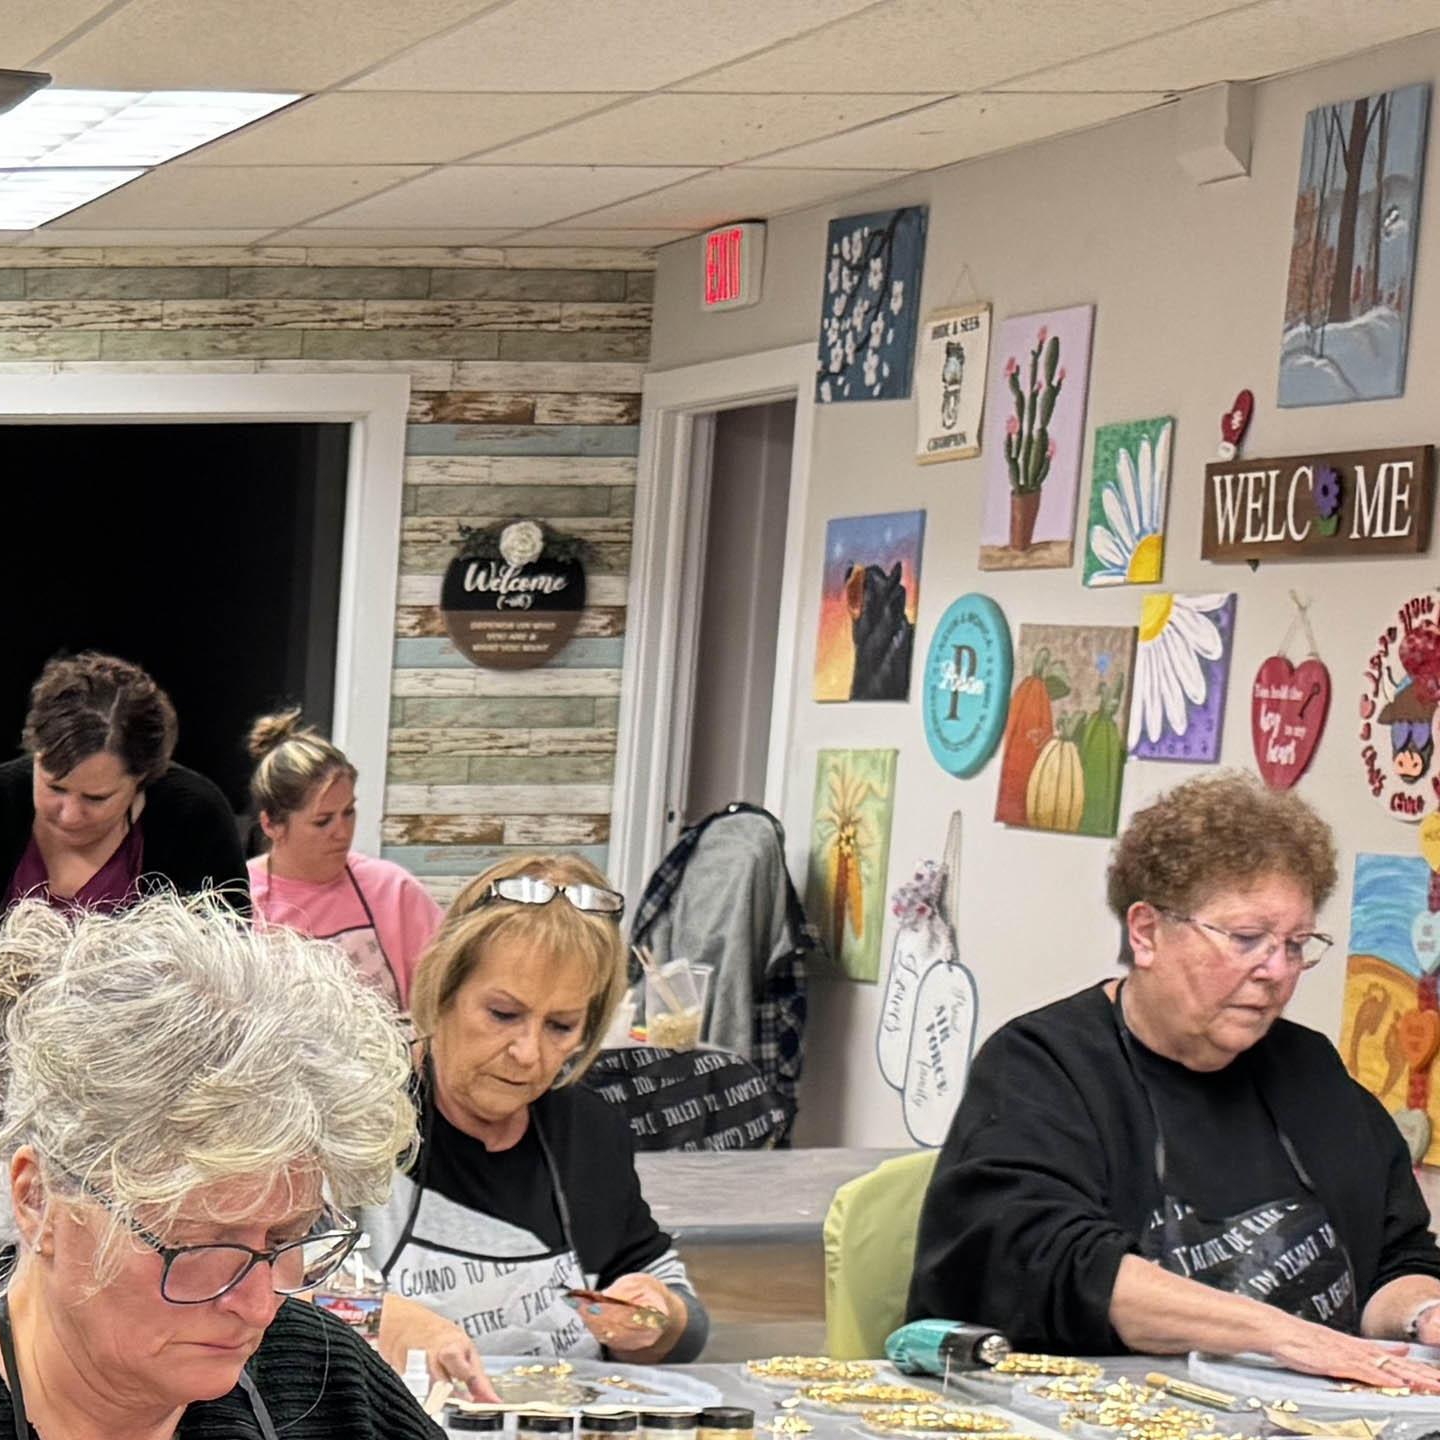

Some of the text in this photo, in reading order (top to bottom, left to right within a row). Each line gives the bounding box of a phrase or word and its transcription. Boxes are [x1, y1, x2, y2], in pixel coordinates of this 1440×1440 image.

[706, 228, 743, 304] EXIT
[464, 562, 569, 594] Welcome
[662, 1099, 700, 1127] LETTRE
[461, 1260, 485, 1285] TU
[455, 1307, 509, 1340] ETTRE
